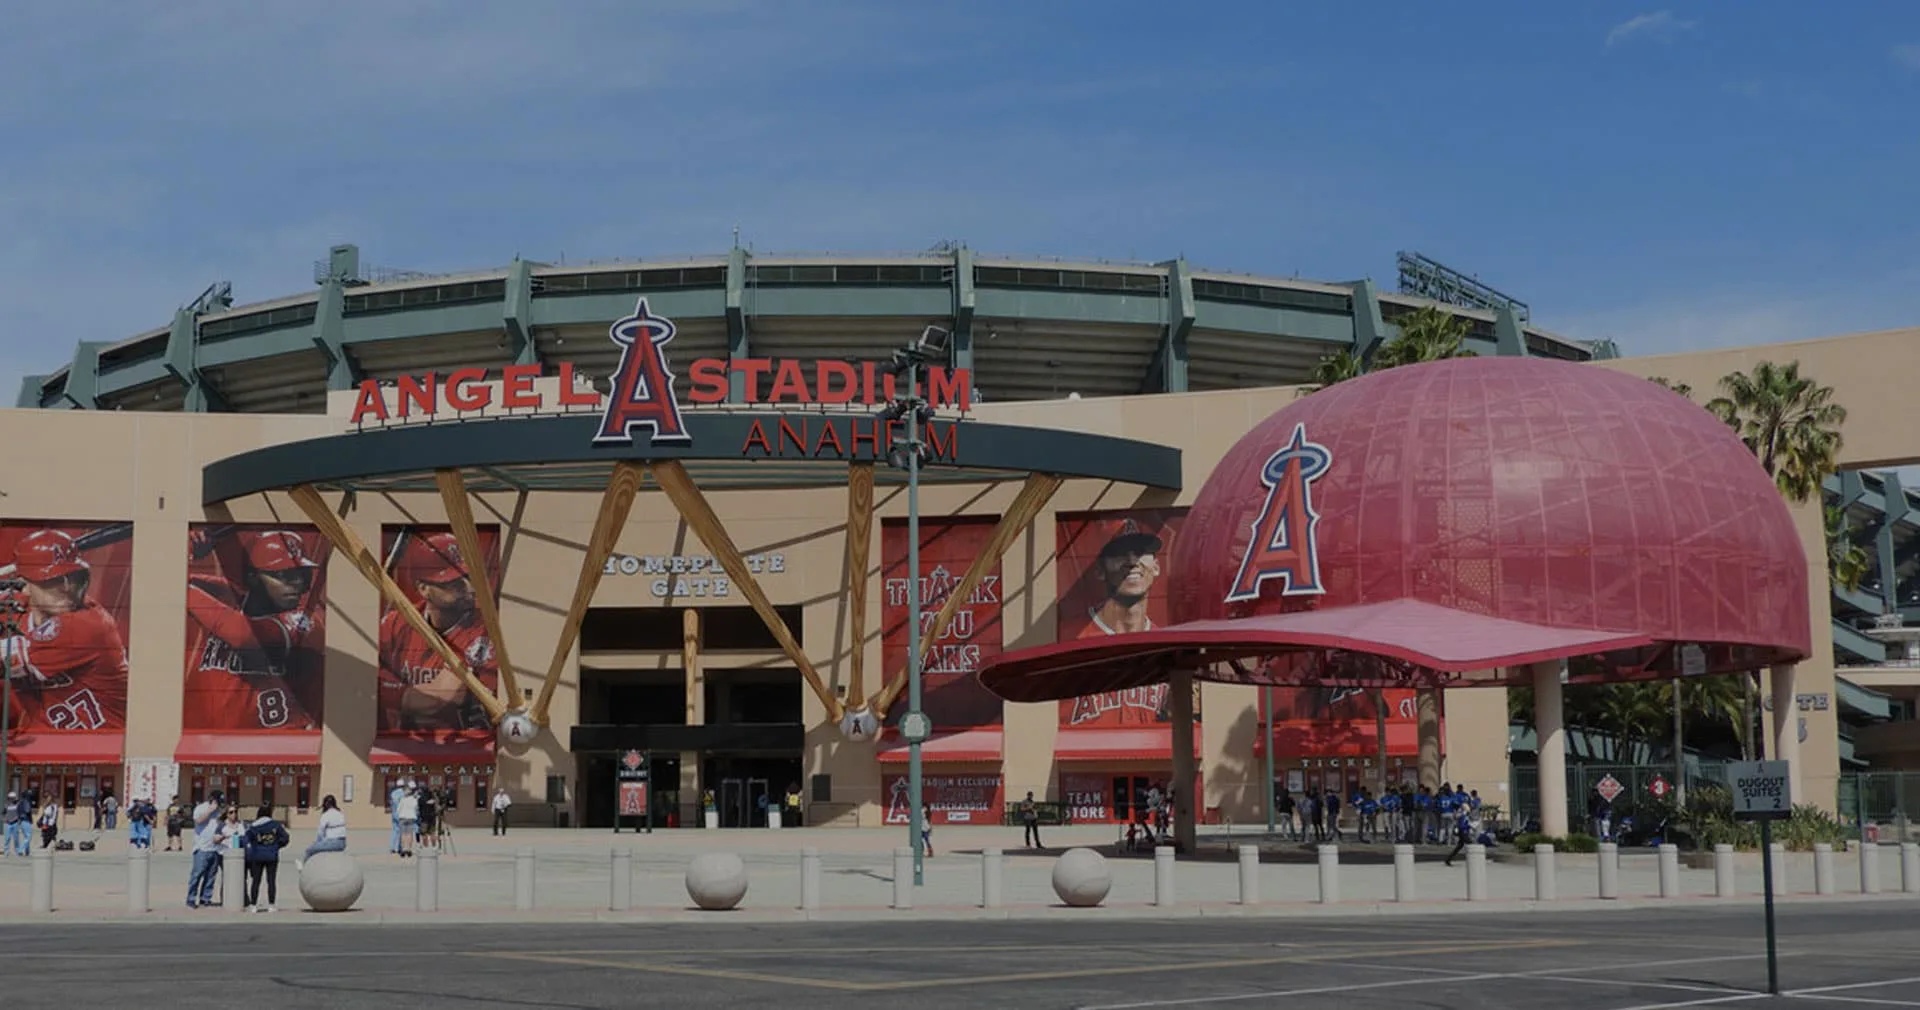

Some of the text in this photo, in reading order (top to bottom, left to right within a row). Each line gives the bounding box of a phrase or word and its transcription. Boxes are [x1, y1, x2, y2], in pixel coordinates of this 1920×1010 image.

[351, 361, 602, 423] ANGEL
[742, 416, 957, 463] ANAHEM
[1224, 422, 1333, 604] A
[602, 555, 785, 575] HOMEPLTE
[651, 578, 730, 598] GATE
[907, 644, 980, 674] ANS
[47, 688, 106, 730] 27
[257, 687, 288, 728] 8
[194, 766, 310, 775] WILL CALL
[380, 765, 494, 775] WILL CALL
[1301, 758, 1403, 768] TICKES
[1737, 776, 1785, 788] DUGOUT
[1067, 792, 1102, 805] TEAM
[1742, 786, 1782, 798] SUITES
[1745, 798, 1781, 809] 1 2
[1065, 806, 1106, 819] STORE
